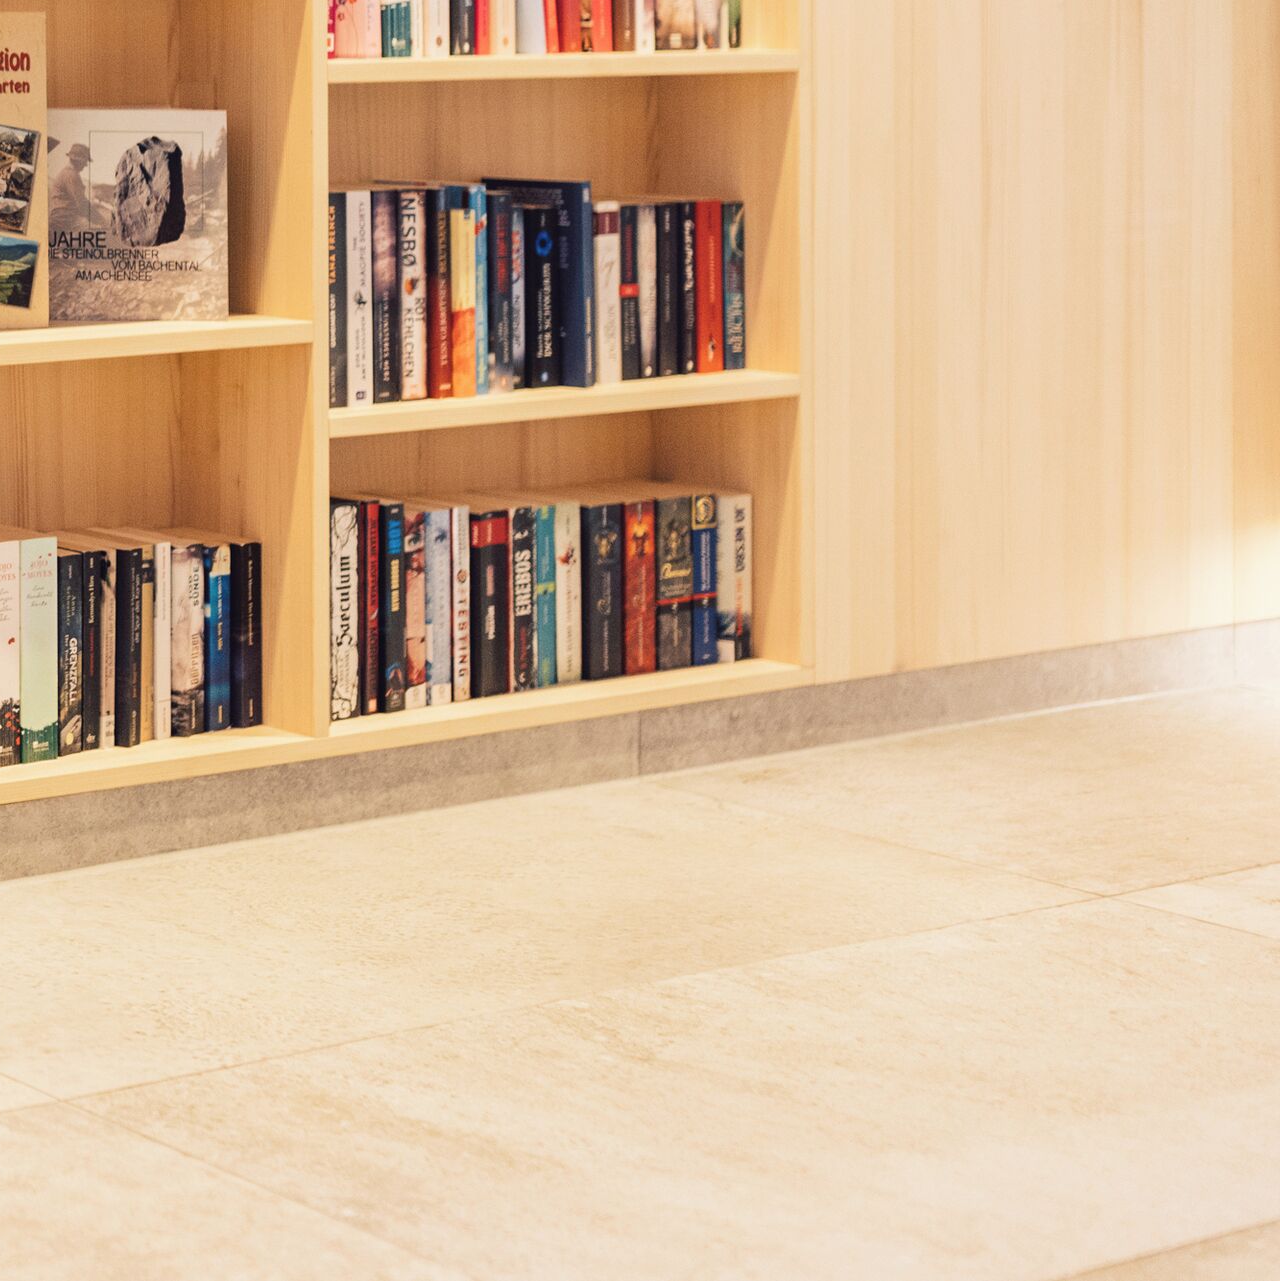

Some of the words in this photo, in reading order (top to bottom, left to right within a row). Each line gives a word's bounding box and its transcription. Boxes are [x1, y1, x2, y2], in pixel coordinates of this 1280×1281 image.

[49, 231, 107, 248] JAHRE
[111, 260, 136, 270] VOM
[139, 260, 201, 271] BACHENTAL
[401, 197, 416, 267] NESBØ
[75, 272, 91, 281] AM
[94, 270, 153, 281] ACHENSEE
[329, 253, 337, 285] TANA
[404, 307, 415, 378] KEHLCHEN
[27, 570, 53, 579] MOYES
[336, 555, 352, 647] Saeculum
[514, 549, 531, 616] EREBOS
[68, 637, 77, 706] GRENZFALL
[457, 599, 468, 678] TESTING
